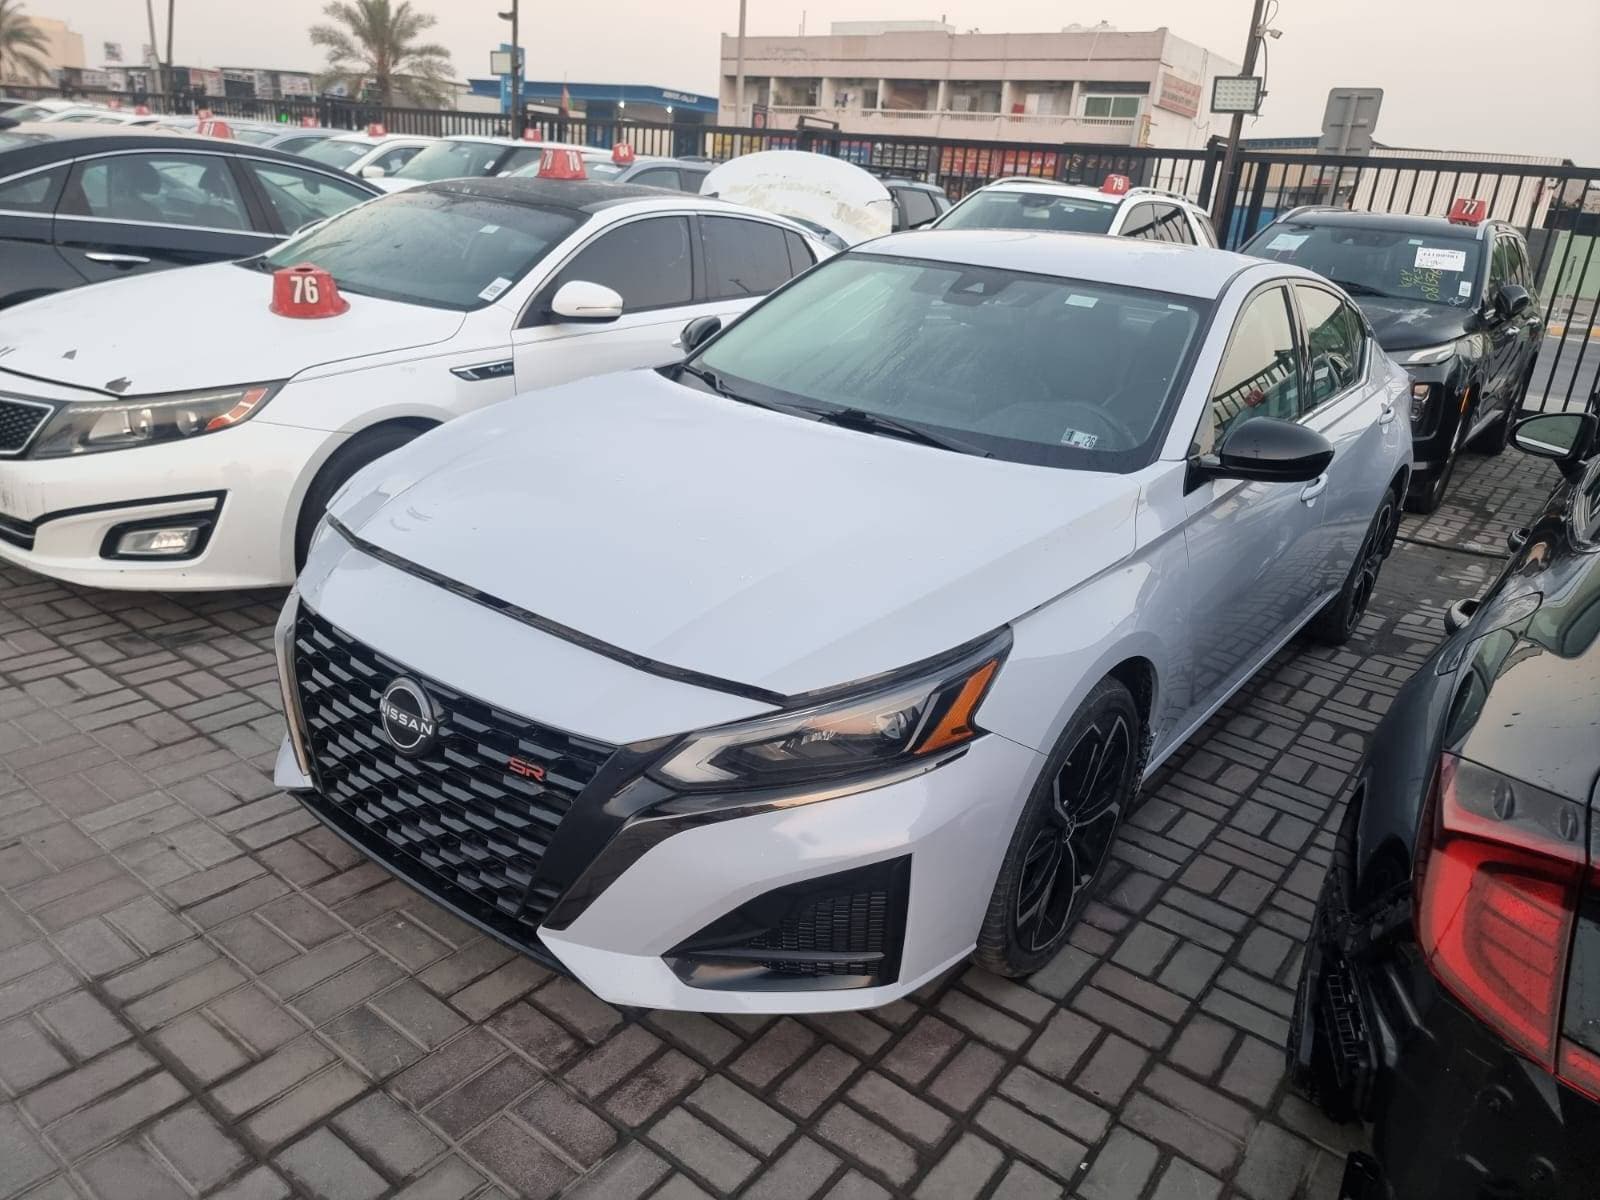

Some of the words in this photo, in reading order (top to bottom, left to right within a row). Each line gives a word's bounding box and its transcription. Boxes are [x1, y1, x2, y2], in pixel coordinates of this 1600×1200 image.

[1112, 177, 1125, 192] 79
[1462, 200, 1478, 215] 77
[289, 275, 320, 304] 76
[379, 698, 433, 736] NISSAN
[508, 756, 546, 782] SR
